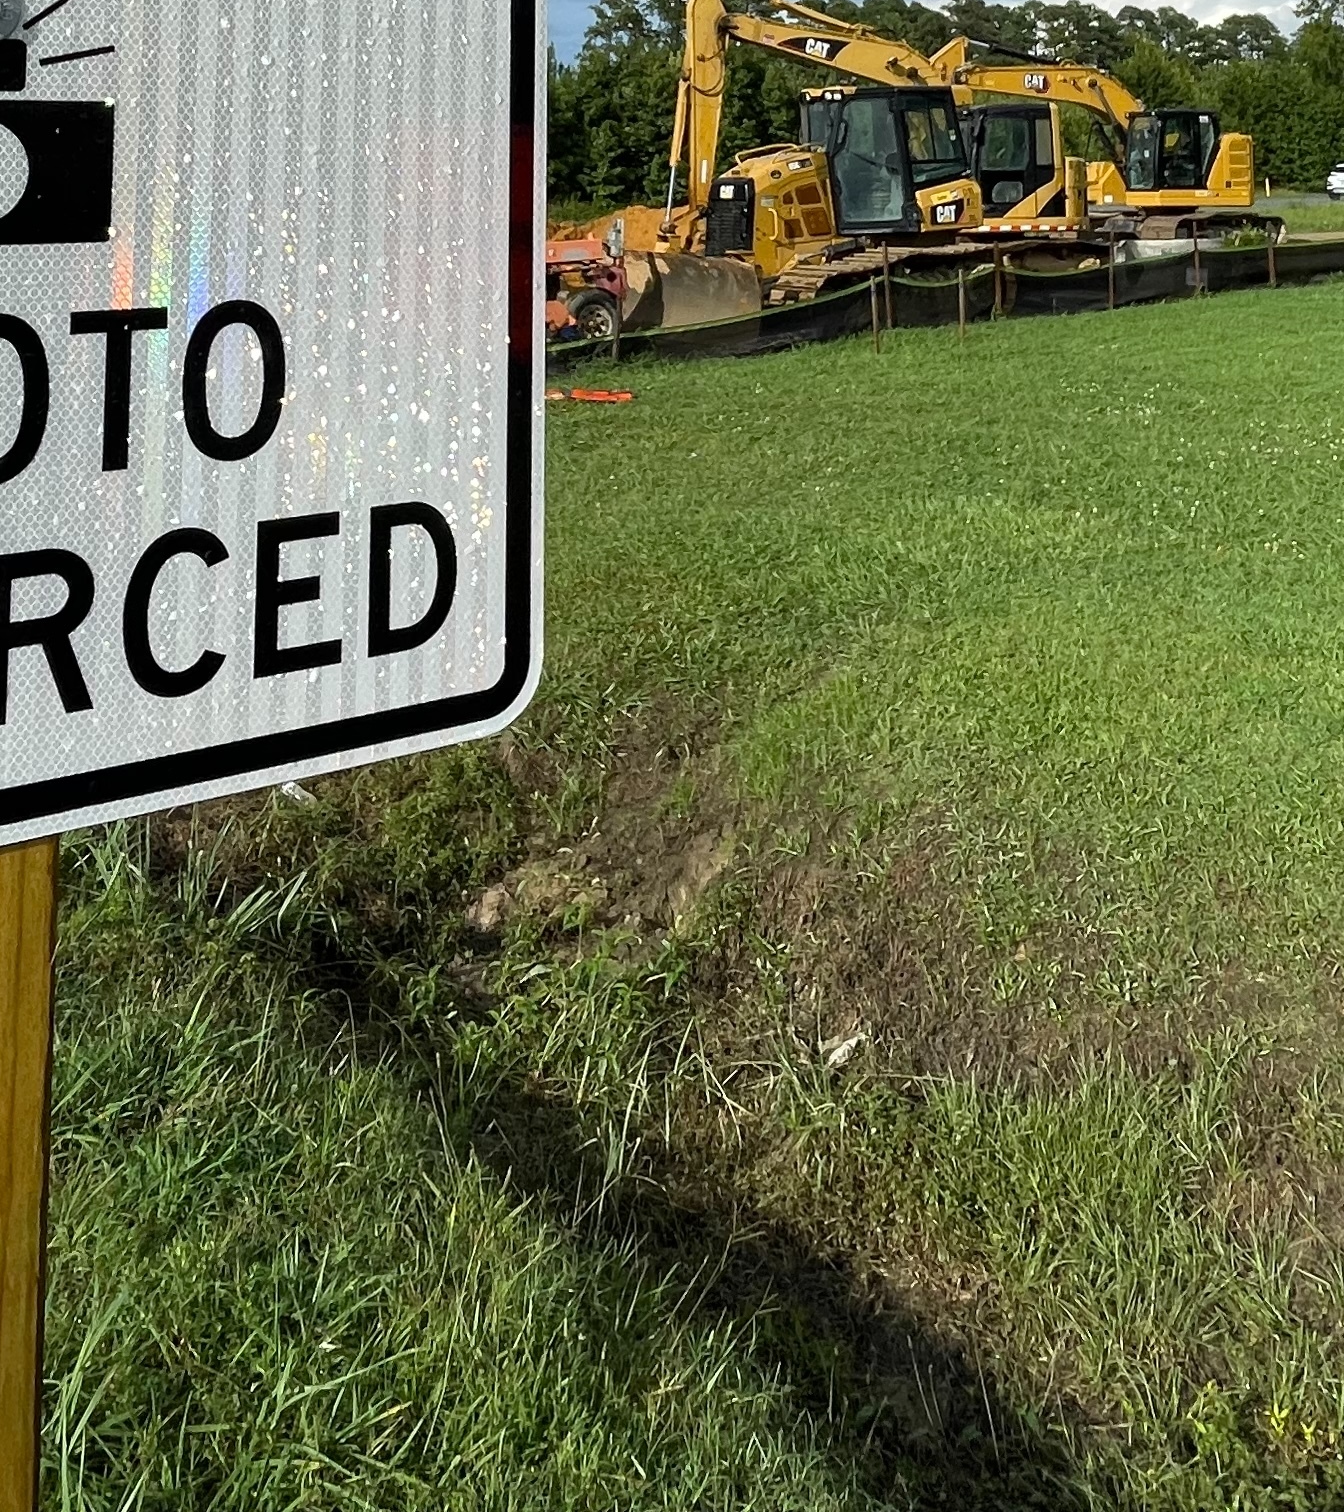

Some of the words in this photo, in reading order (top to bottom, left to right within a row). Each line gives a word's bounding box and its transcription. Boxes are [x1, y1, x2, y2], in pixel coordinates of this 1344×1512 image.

[805, 38, 831, 58] CAT
[1024, 74, 1045, 90] CAT
[936, 204, 957, 223] CAT
